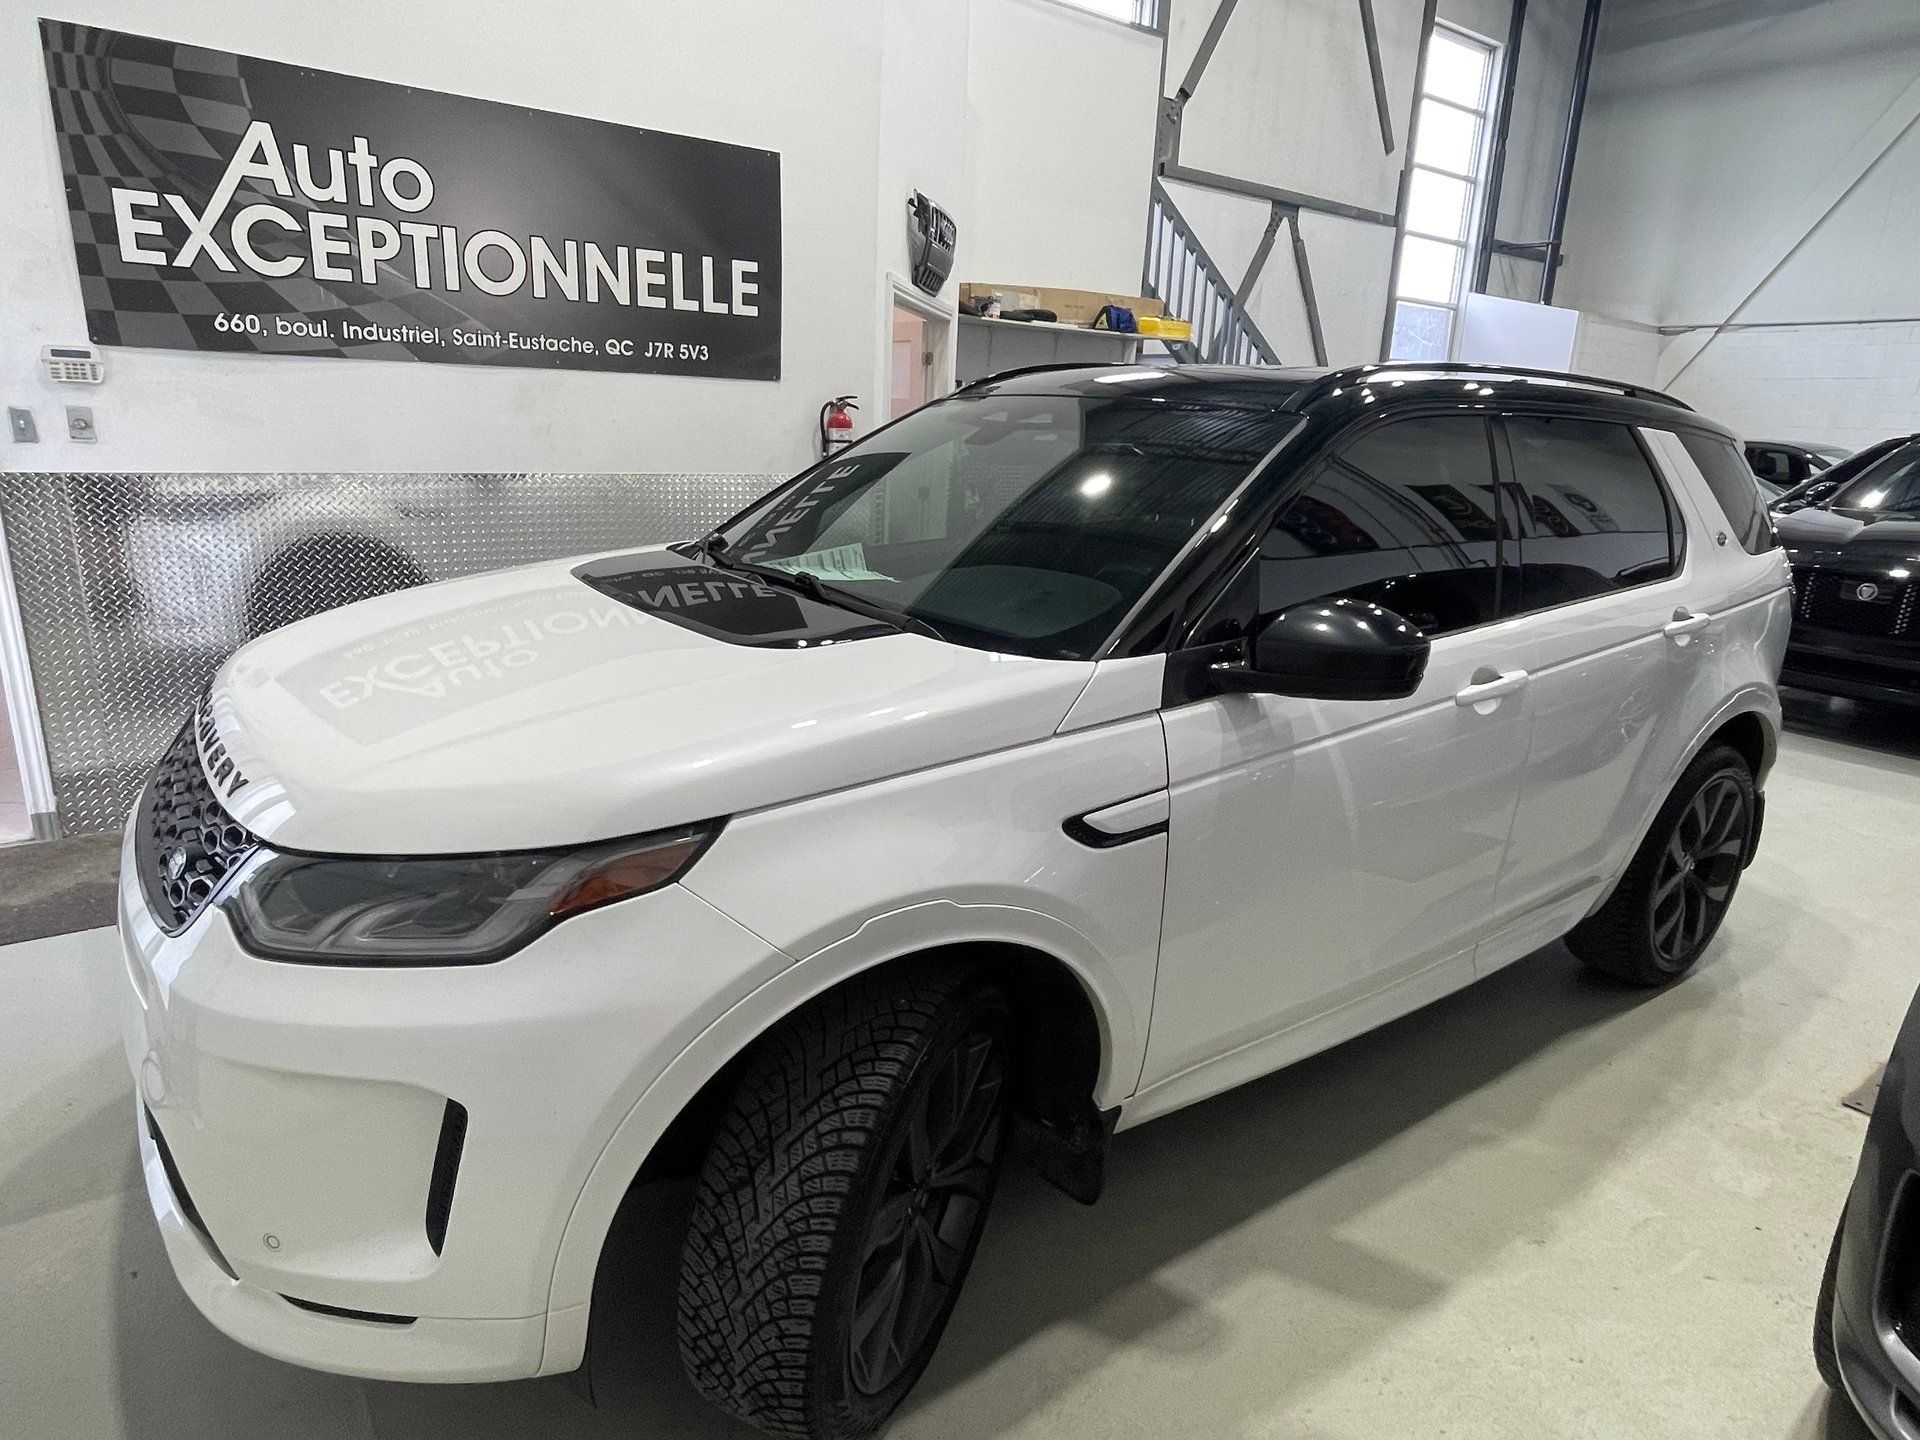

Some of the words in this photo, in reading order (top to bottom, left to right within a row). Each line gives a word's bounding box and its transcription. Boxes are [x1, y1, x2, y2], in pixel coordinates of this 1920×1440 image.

[208, 119, 435, 213] Auto
[110, 186, 760, 317] EXCEPTIONNELLE
[213, 312, 268, 336] 660,
[275, 316, 335, 338] boul.
[342, 321, 446, 347] Industriel,
[452, 328, 599, 356] Saint-Eustache,
[604, 338, 634, 356] QC
[644, 341, 674, 359] J7R
[679, 344, 709, 361] 5V3
